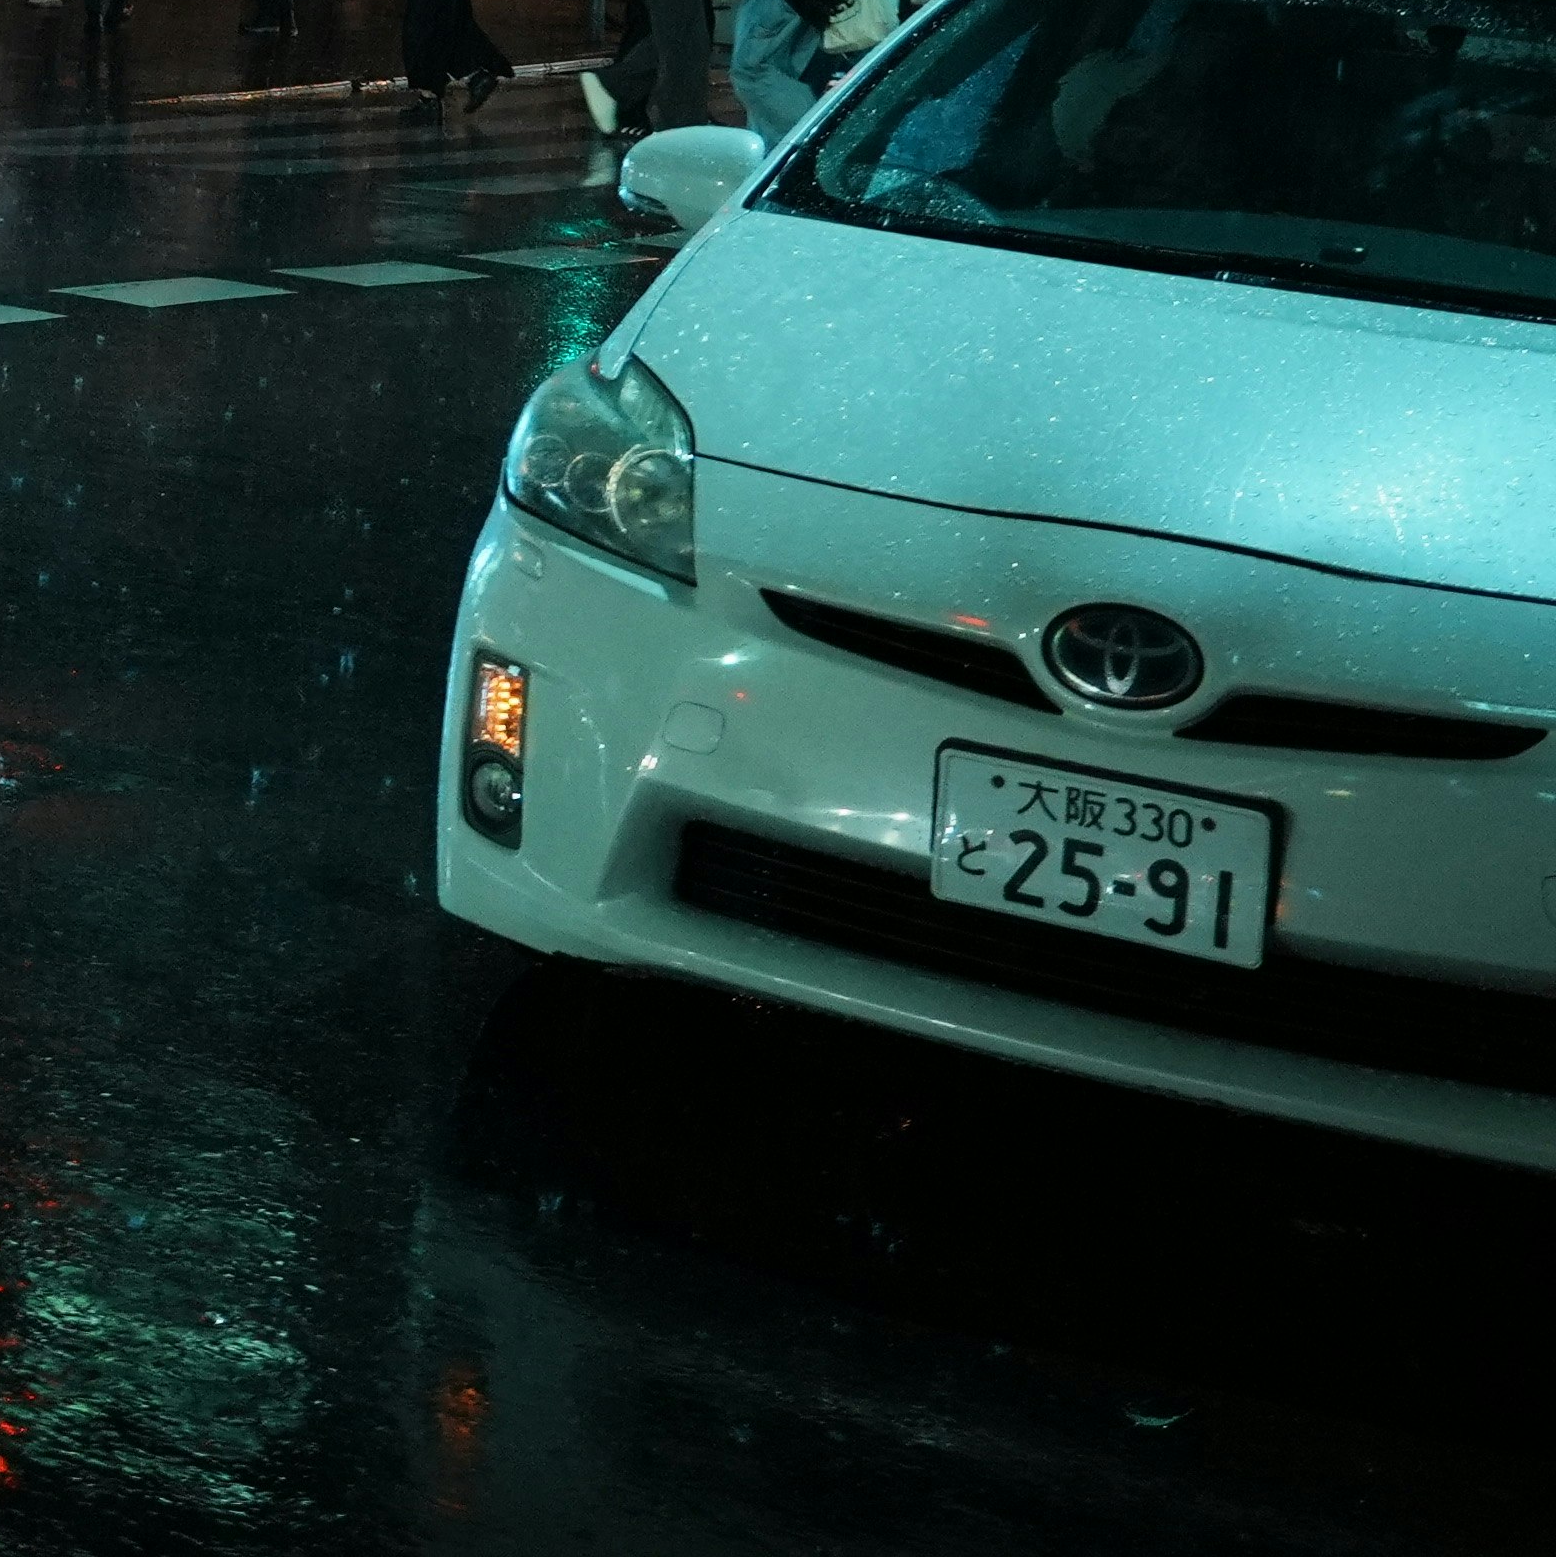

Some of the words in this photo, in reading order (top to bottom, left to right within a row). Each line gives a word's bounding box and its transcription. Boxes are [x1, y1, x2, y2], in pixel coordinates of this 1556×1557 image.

[1017, 780, 1194, 848] 大阪330
[957, 835, 986, 876] と
[1003, 829, 1234, 950] 25-91
